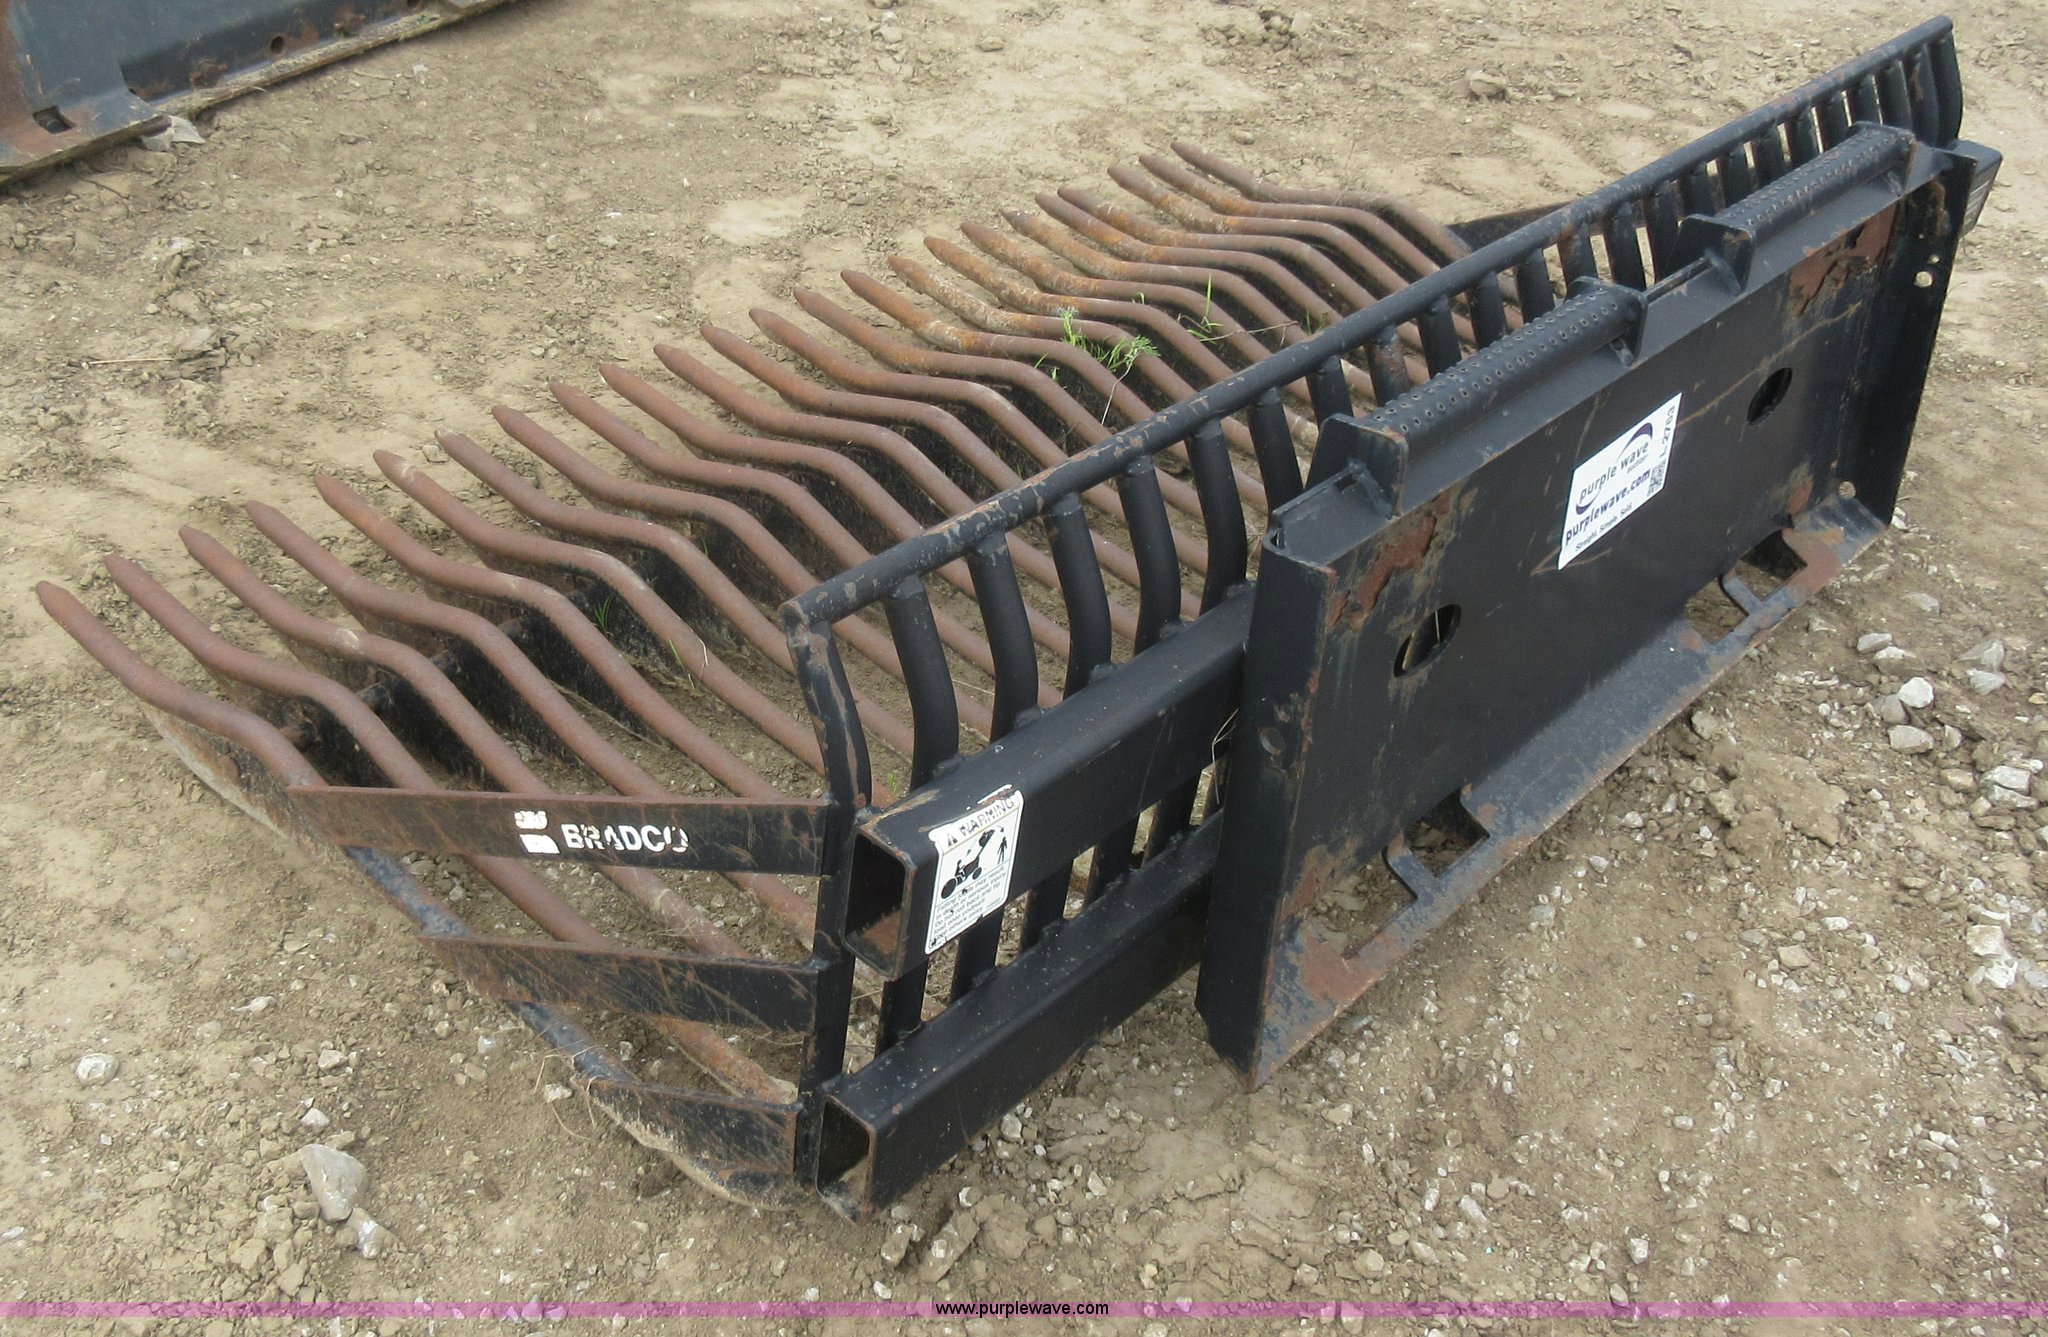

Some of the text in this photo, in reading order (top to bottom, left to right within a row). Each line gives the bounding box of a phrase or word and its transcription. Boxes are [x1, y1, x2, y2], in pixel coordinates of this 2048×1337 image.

[1579, 441, 1649, 504] purple wave
[1565, 468, 1651, 547] purplewave.com
[561, 823, 690, 853] BRADCO
[959, 800, 1015, 838] WARNING
